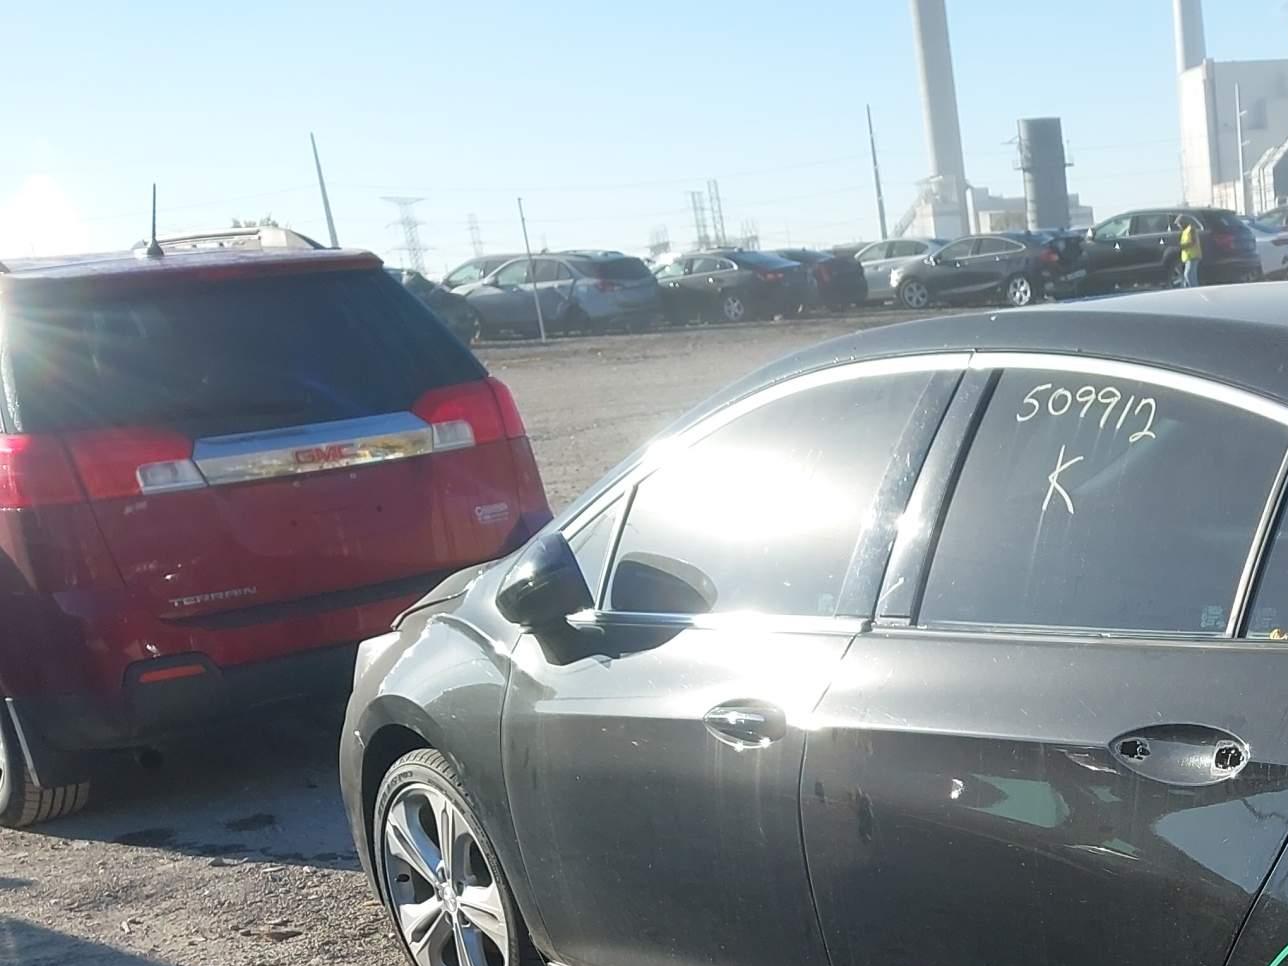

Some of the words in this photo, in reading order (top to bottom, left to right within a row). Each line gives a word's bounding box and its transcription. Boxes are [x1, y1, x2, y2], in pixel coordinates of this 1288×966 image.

[1016, 383, 1157, 443] 509912
[1041, 444, 1085, 515] K
[168, 586, 257, 607] TERRAIN
